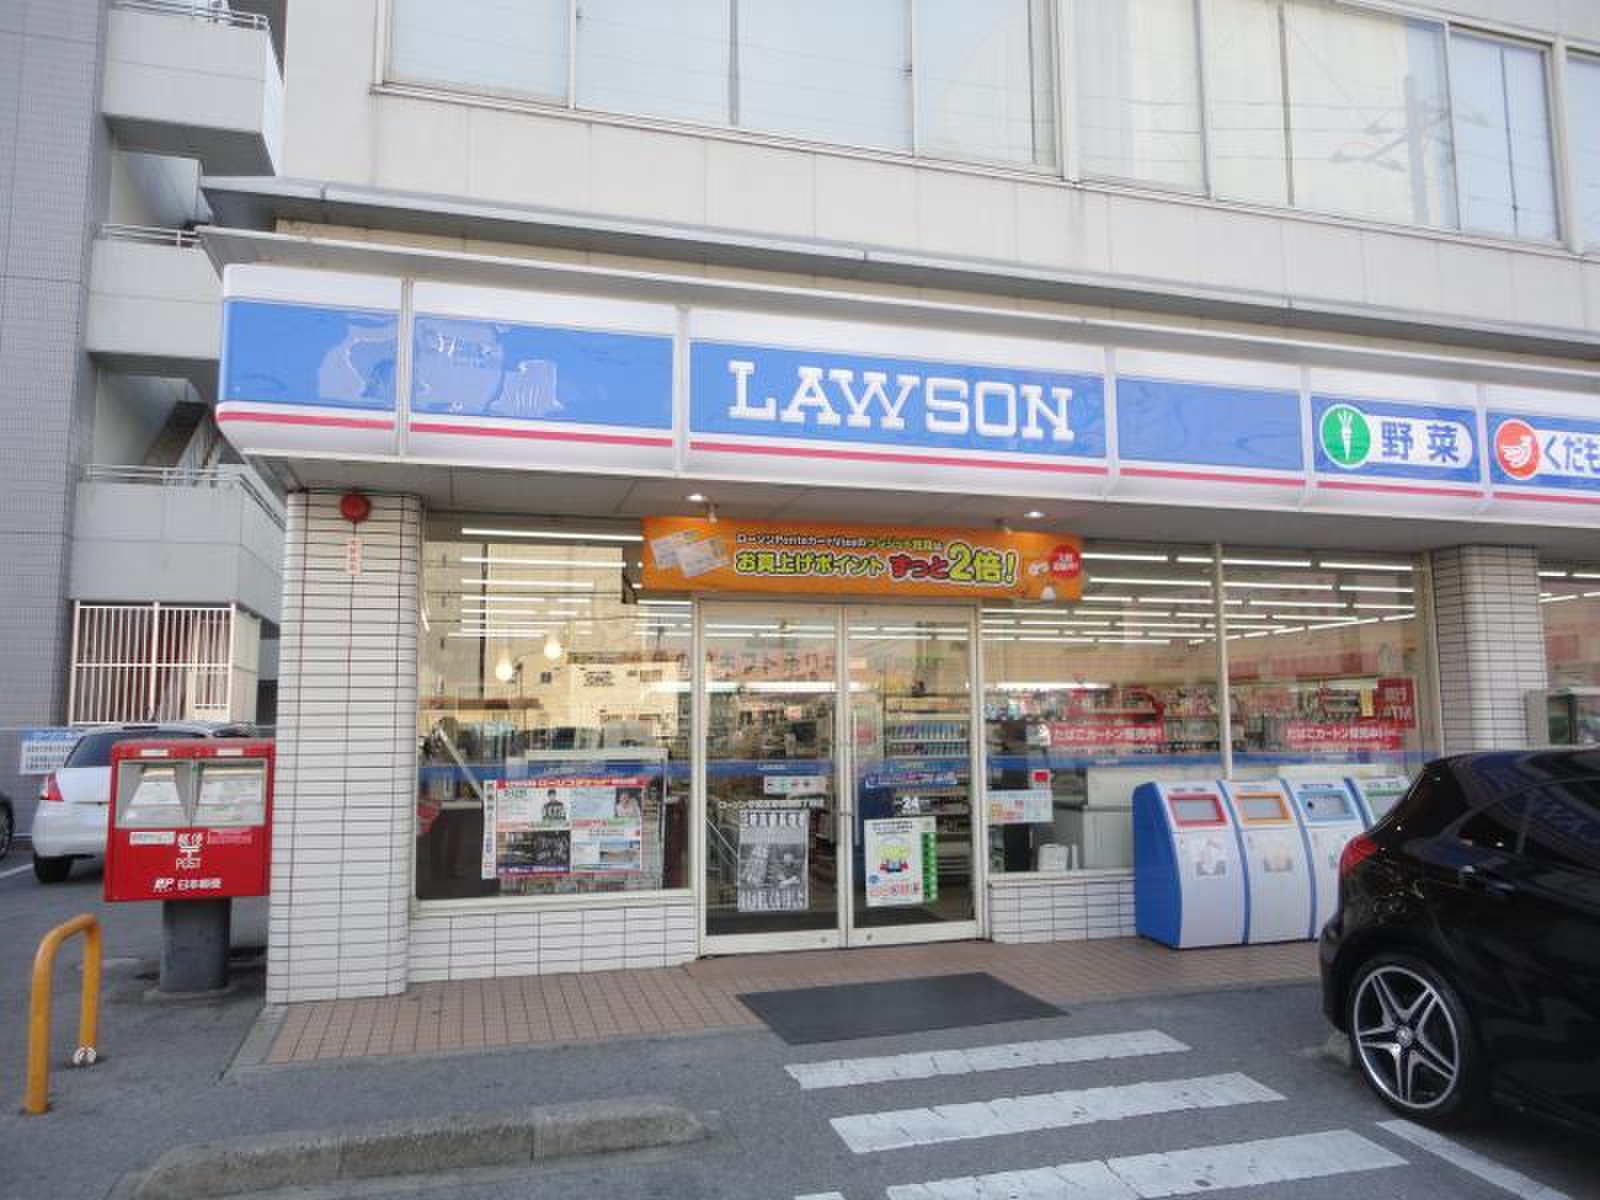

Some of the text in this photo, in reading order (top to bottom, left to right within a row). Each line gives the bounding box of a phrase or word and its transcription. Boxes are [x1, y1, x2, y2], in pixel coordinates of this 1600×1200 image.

[728, 360, 1075, 442] LAWSON
[1381, 421, 1460, 463] 野菜
[735, 550, 884, 577] お買上げポイント
[176, 857, 201, 870] POST
